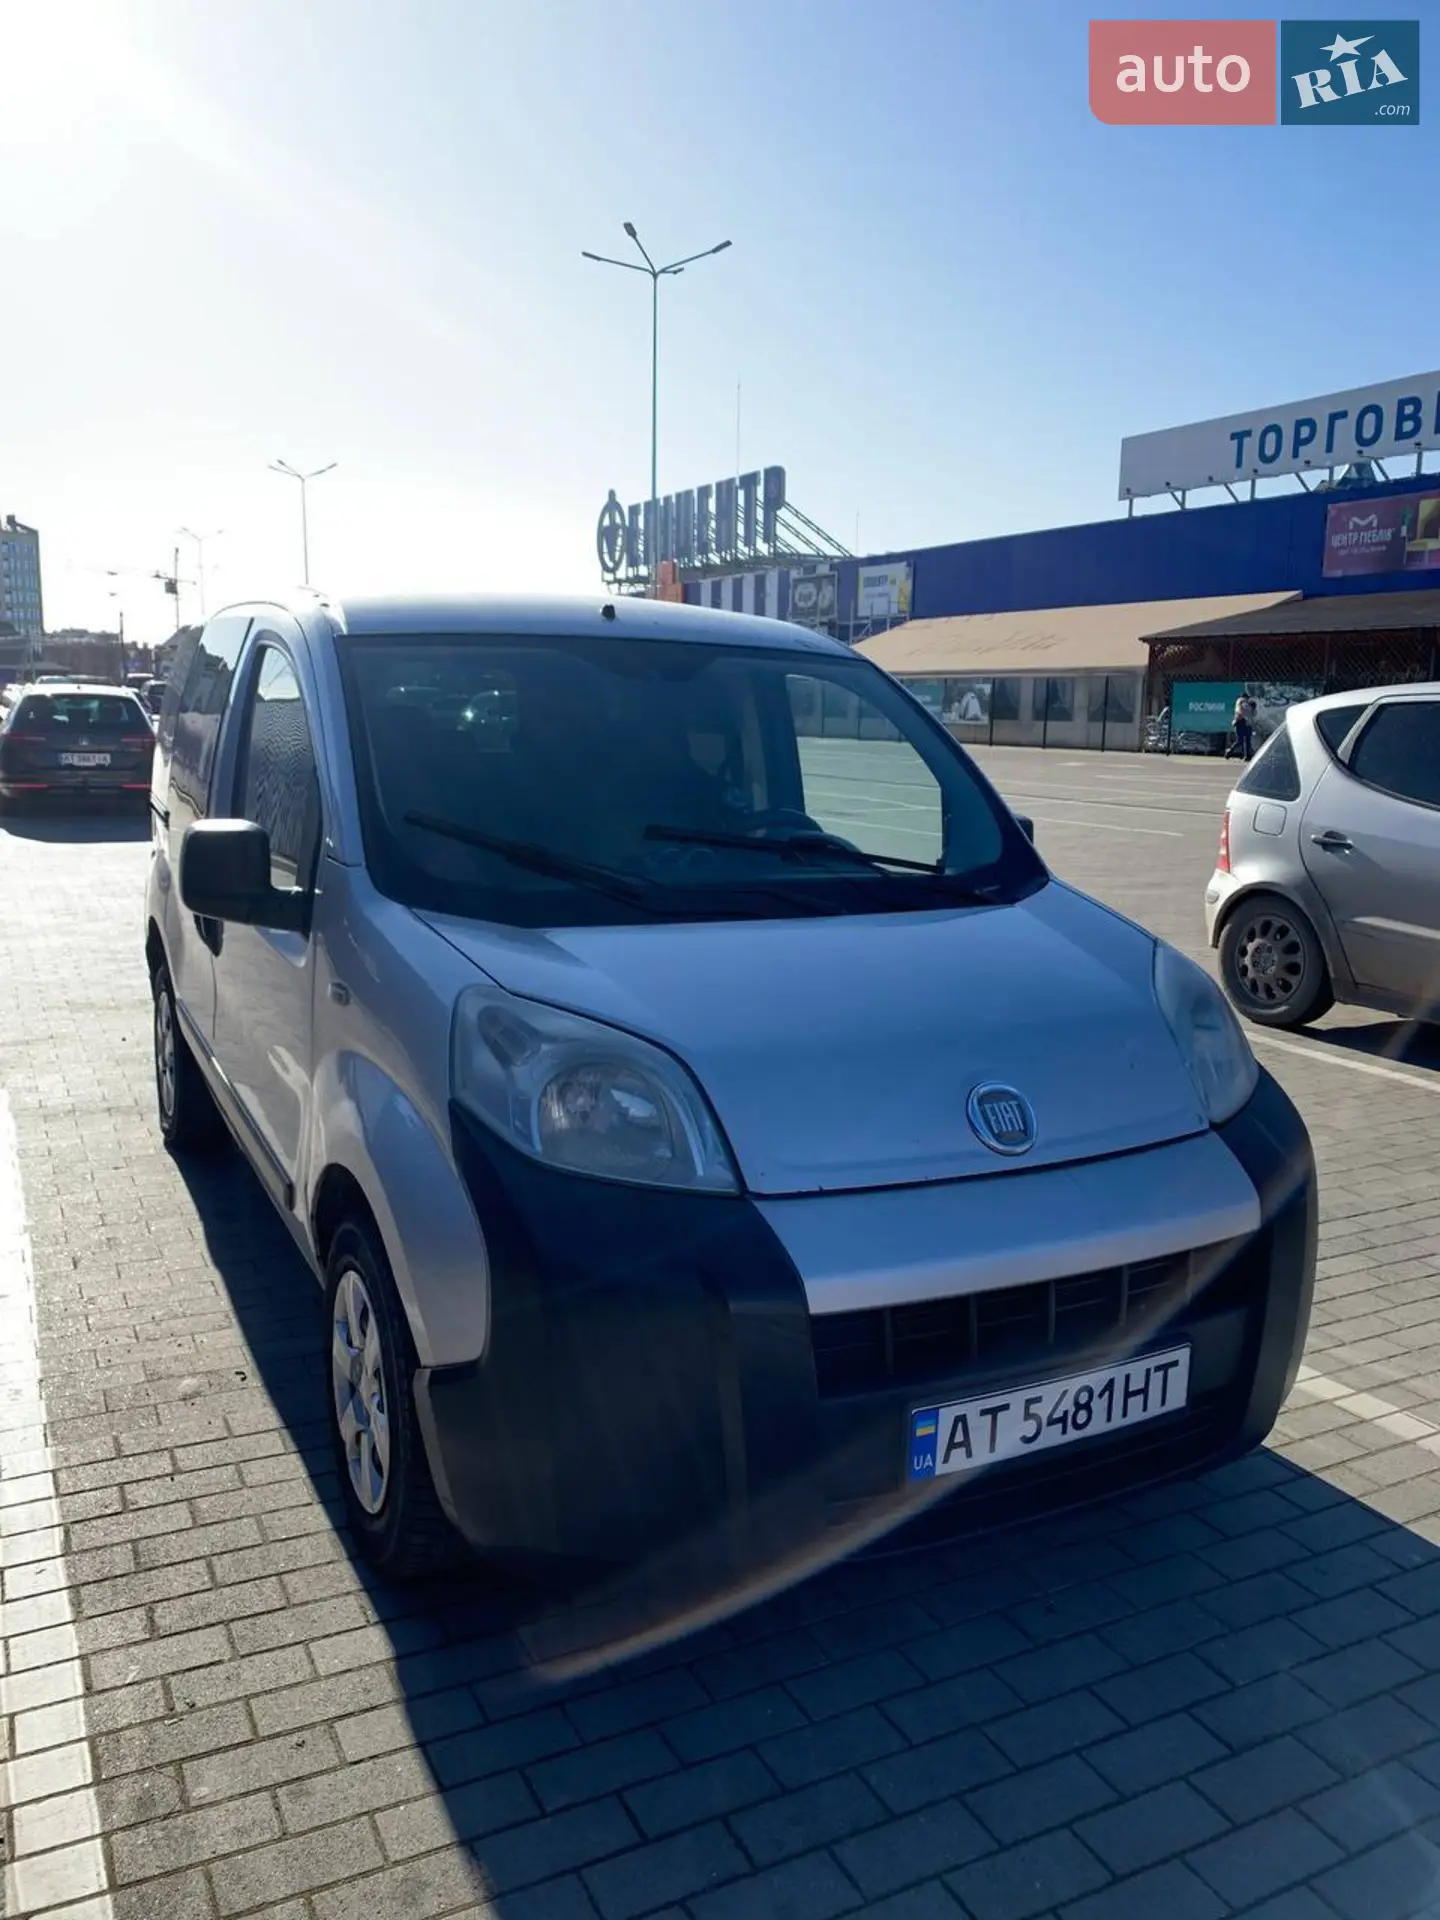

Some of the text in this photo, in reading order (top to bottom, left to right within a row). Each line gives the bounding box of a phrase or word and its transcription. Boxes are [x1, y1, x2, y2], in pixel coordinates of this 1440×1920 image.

[1229, 391, 1440, 469] ТОРГОВ
[983, 1100, 1025, 1134] FIAT
[913, 1453, 935, 1471] UA
